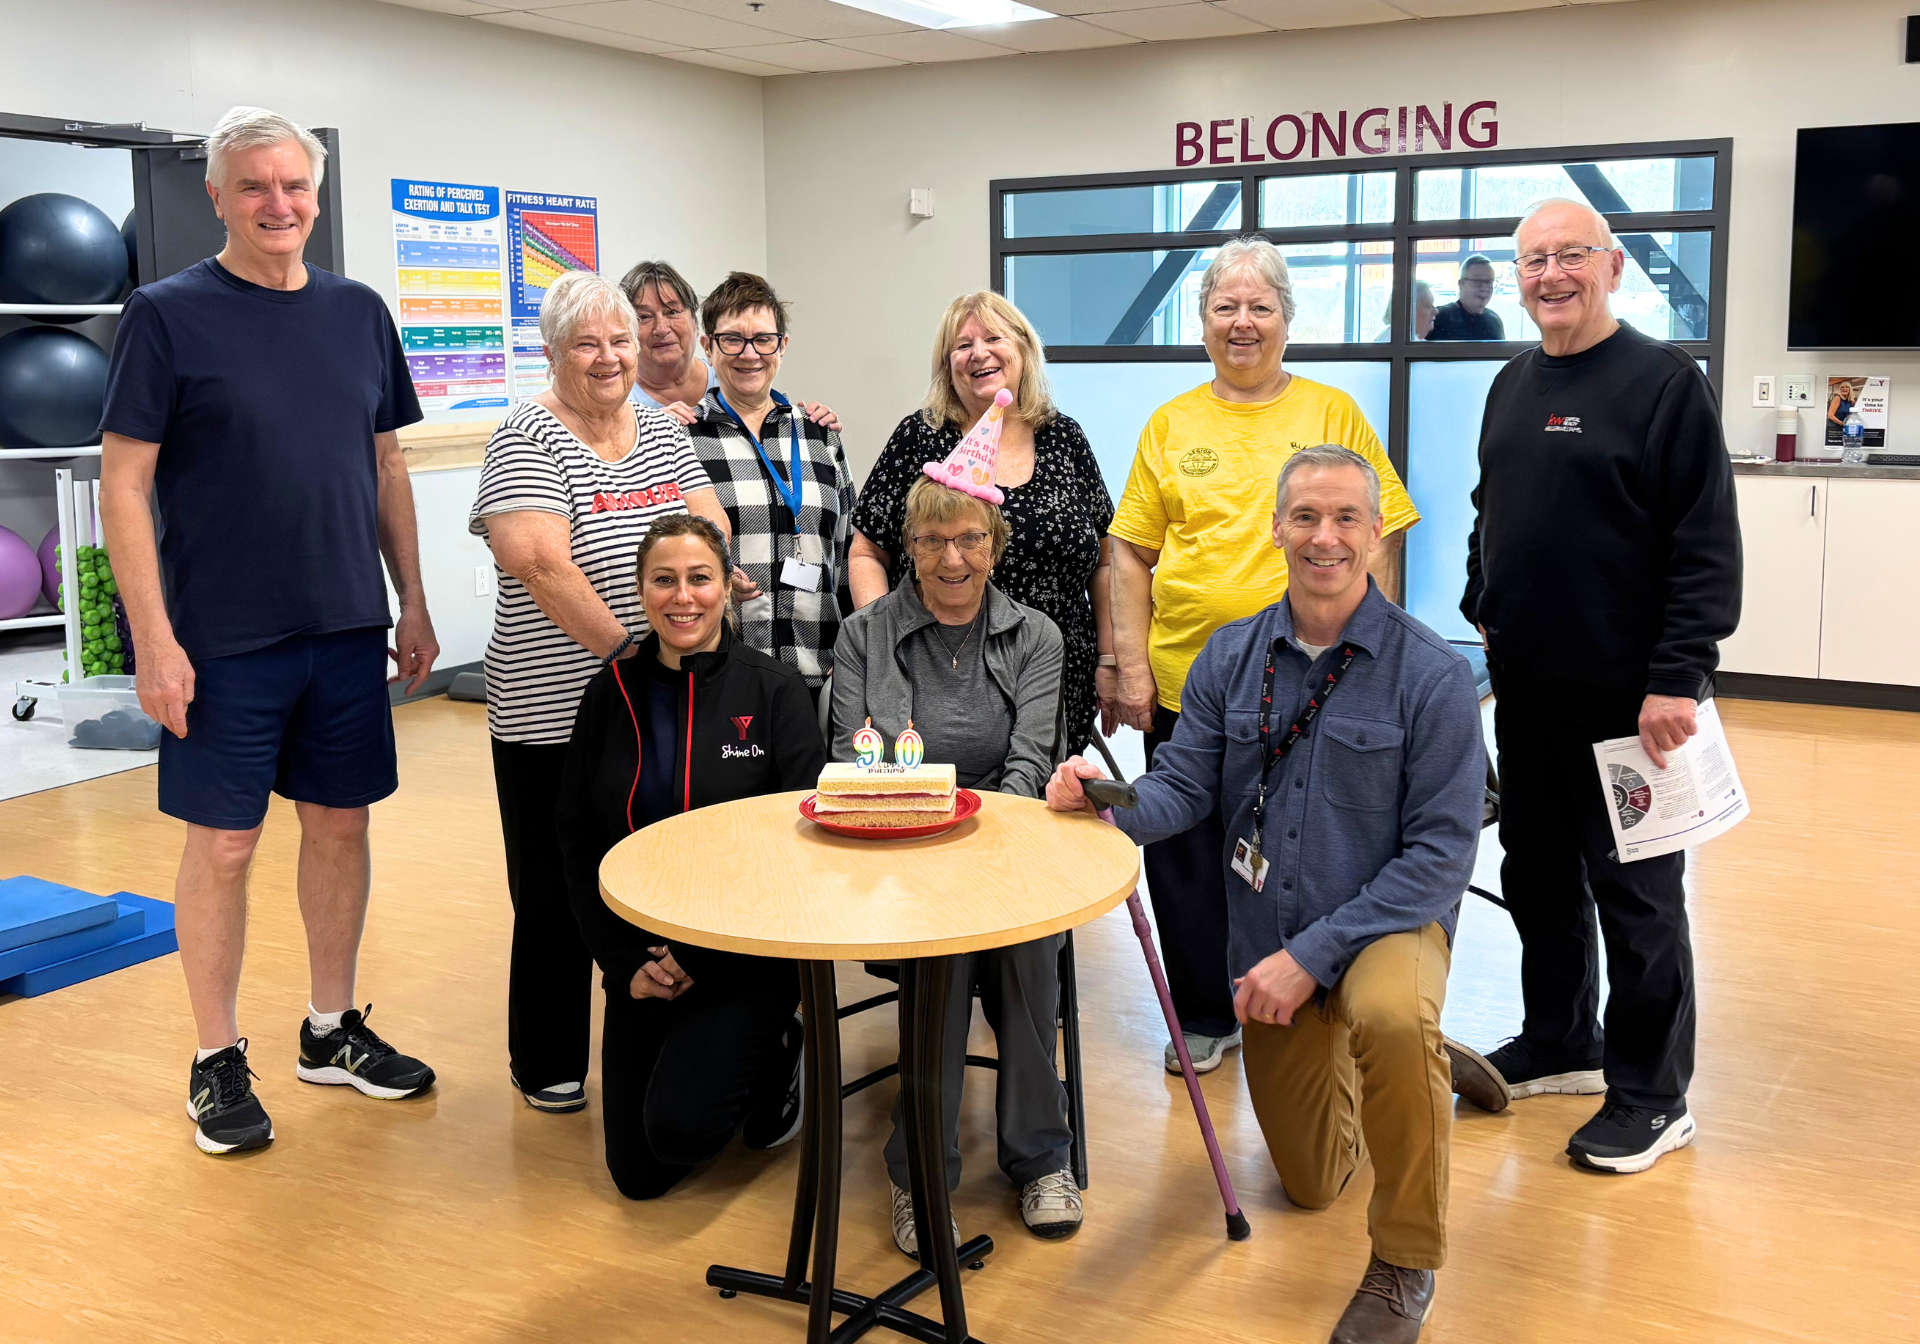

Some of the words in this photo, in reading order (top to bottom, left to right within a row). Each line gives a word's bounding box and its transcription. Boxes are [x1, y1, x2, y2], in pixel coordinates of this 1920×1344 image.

[1176, 100, 1499, 167] BELONGING
[408, 184, 435, 198] RATING
[436, 186, 446, 198] OF
[447, 187, 485, 201] PERCEIVED
[507, 193, 545, 206] FITNESS
[546, 196, 574, 207] HEART
[575, 198, 596, 209] RATE
[404, 198, 439, 212] EXERTION
[440, 200, 455, 213] AND
[456, 201, 474, 214] TALK
[474, 203, 491, 215] TEST
[721, 744, 750, 759] Shine
[751, 744, 765, 758] On
